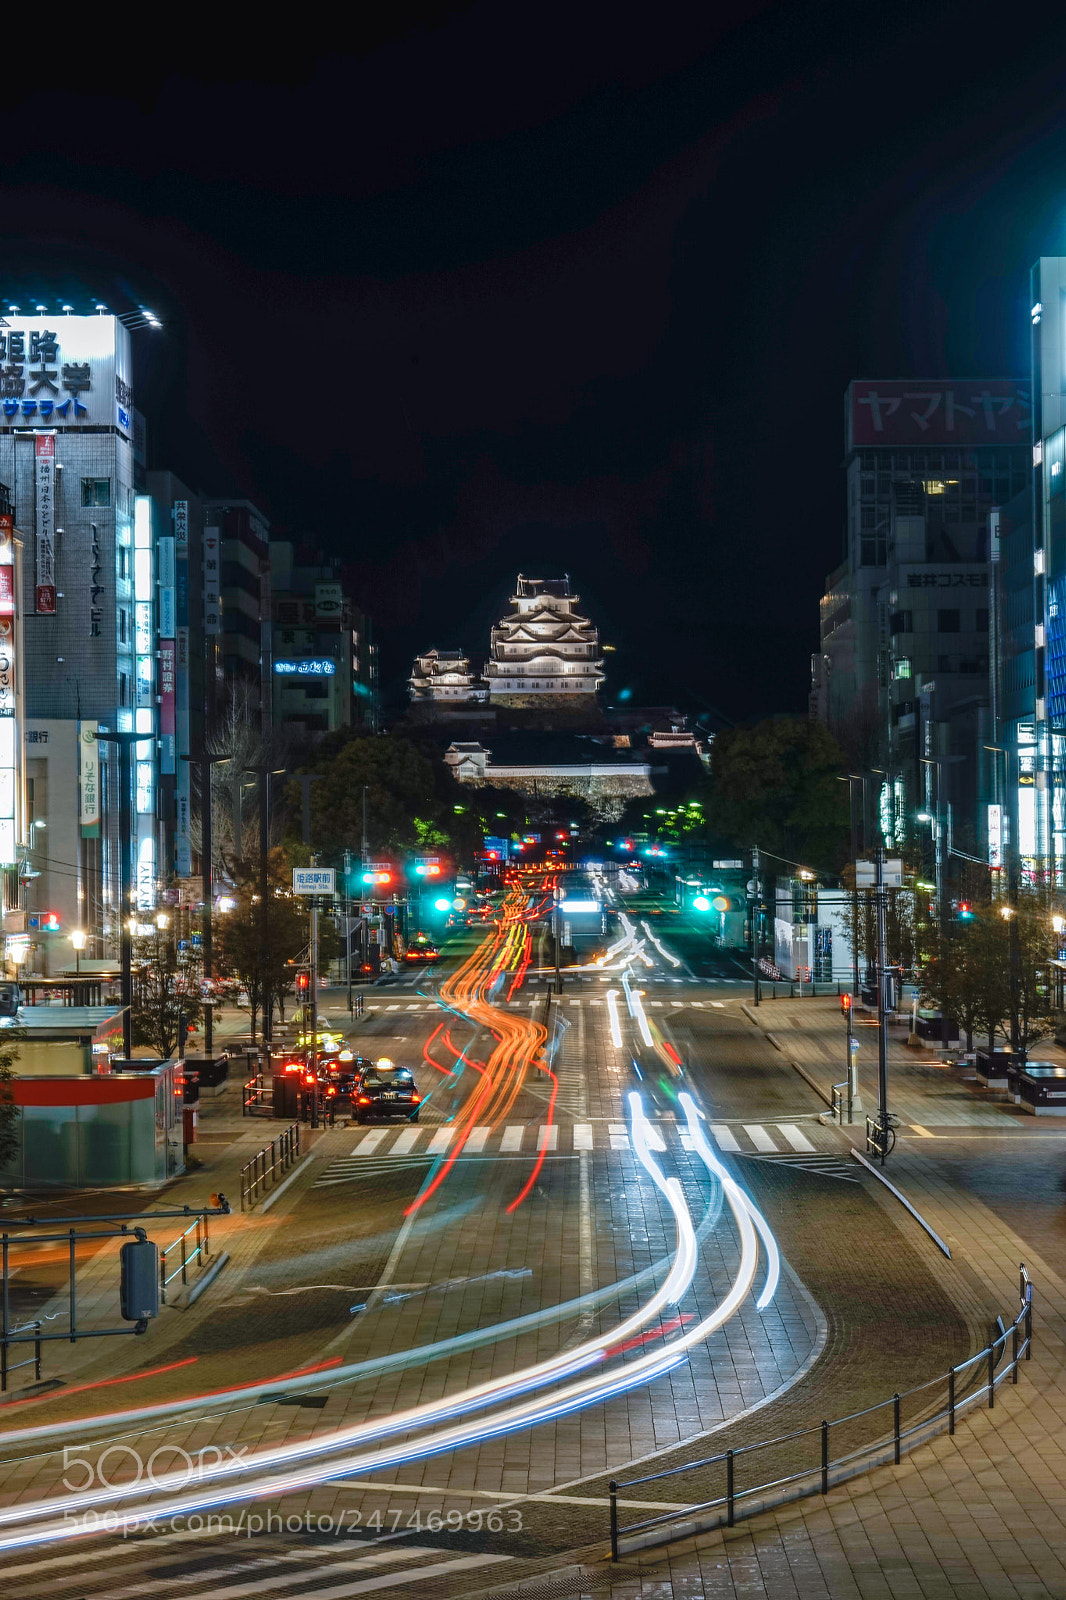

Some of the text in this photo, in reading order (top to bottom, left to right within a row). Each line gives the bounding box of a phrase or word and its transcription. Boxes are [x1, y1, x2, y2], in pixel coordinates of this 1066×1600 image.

[2, 398, 87, 416] サテライト
[176, 501, 187, 541] 共栄火災
[206, 559, 217, 625] 第一生命
[24, 731, 48, 743] 銀行
[84, 761, 96, 814] りそな銀行
[297, 873, 331, 884] 姫路駅前
